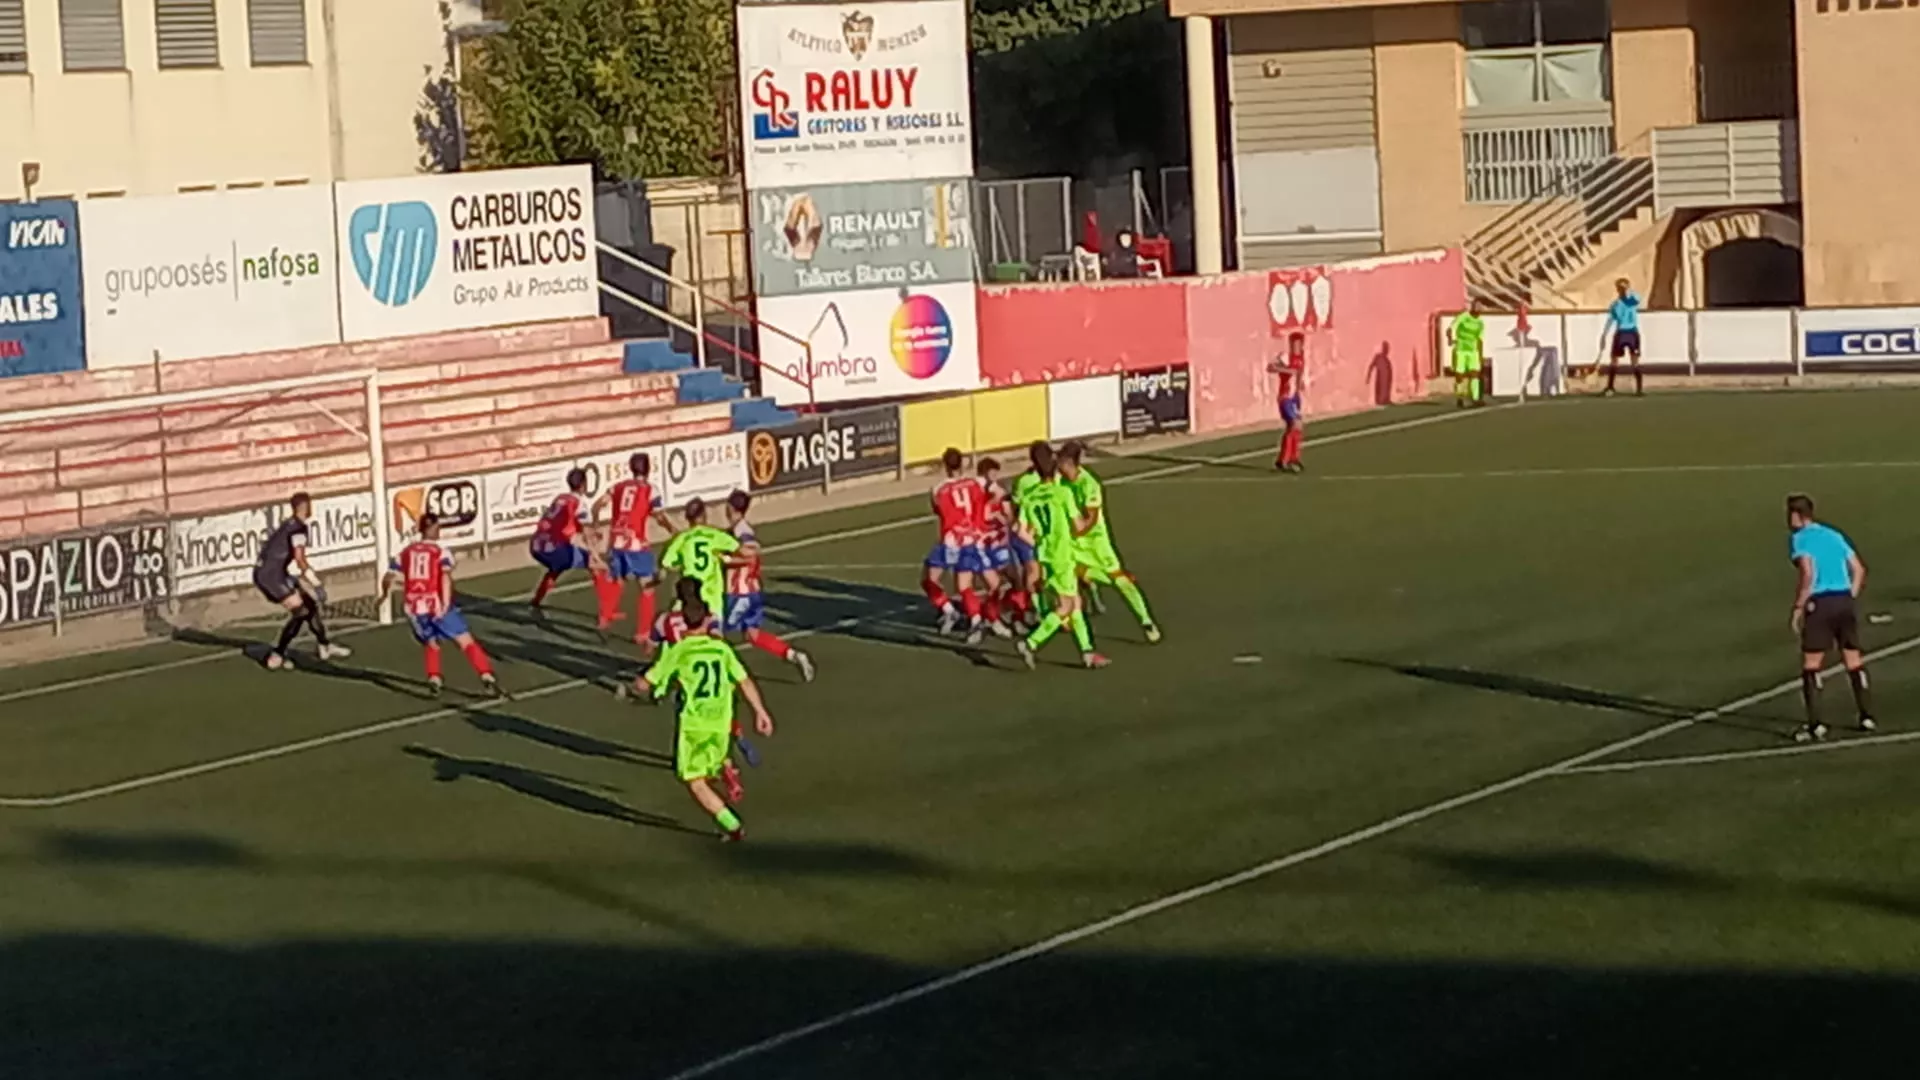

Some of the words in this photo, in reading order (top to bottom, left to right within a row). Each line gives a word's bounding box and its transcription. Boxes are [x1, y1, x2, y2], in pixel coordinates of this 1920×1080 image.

[806, 67, 918, 113] RALUY
[807, 116, 867, 135] GESTORES
[872, 117, 881, 130] Y
[886, 113, 942, 131] ASESORES
[451, 187, 582, 230] CARBUROS
[829, 210, 922, 234] RENAULT
[243, 247, 320, 282] nafosa
[452, 228, 586, 273] METALICOS
[105, 254, 228, 302] grupoosés
[856, 262, 905, 284] Blanco
[454, 284, 498, 307] Grupo
[504, 280, 524, 300] Air
[528, 273, 590, 297] Products
[786, 353, 877, 379] alumbra
[779, 426, 856, 473] TAGSE
[427, 485, 478, 516] SGR
[620, 487, 634, 512] 6
[952, 487, 972, 516] 4
[693, 541, 710, 572] 5
[692, 660, 721, 699] 21
